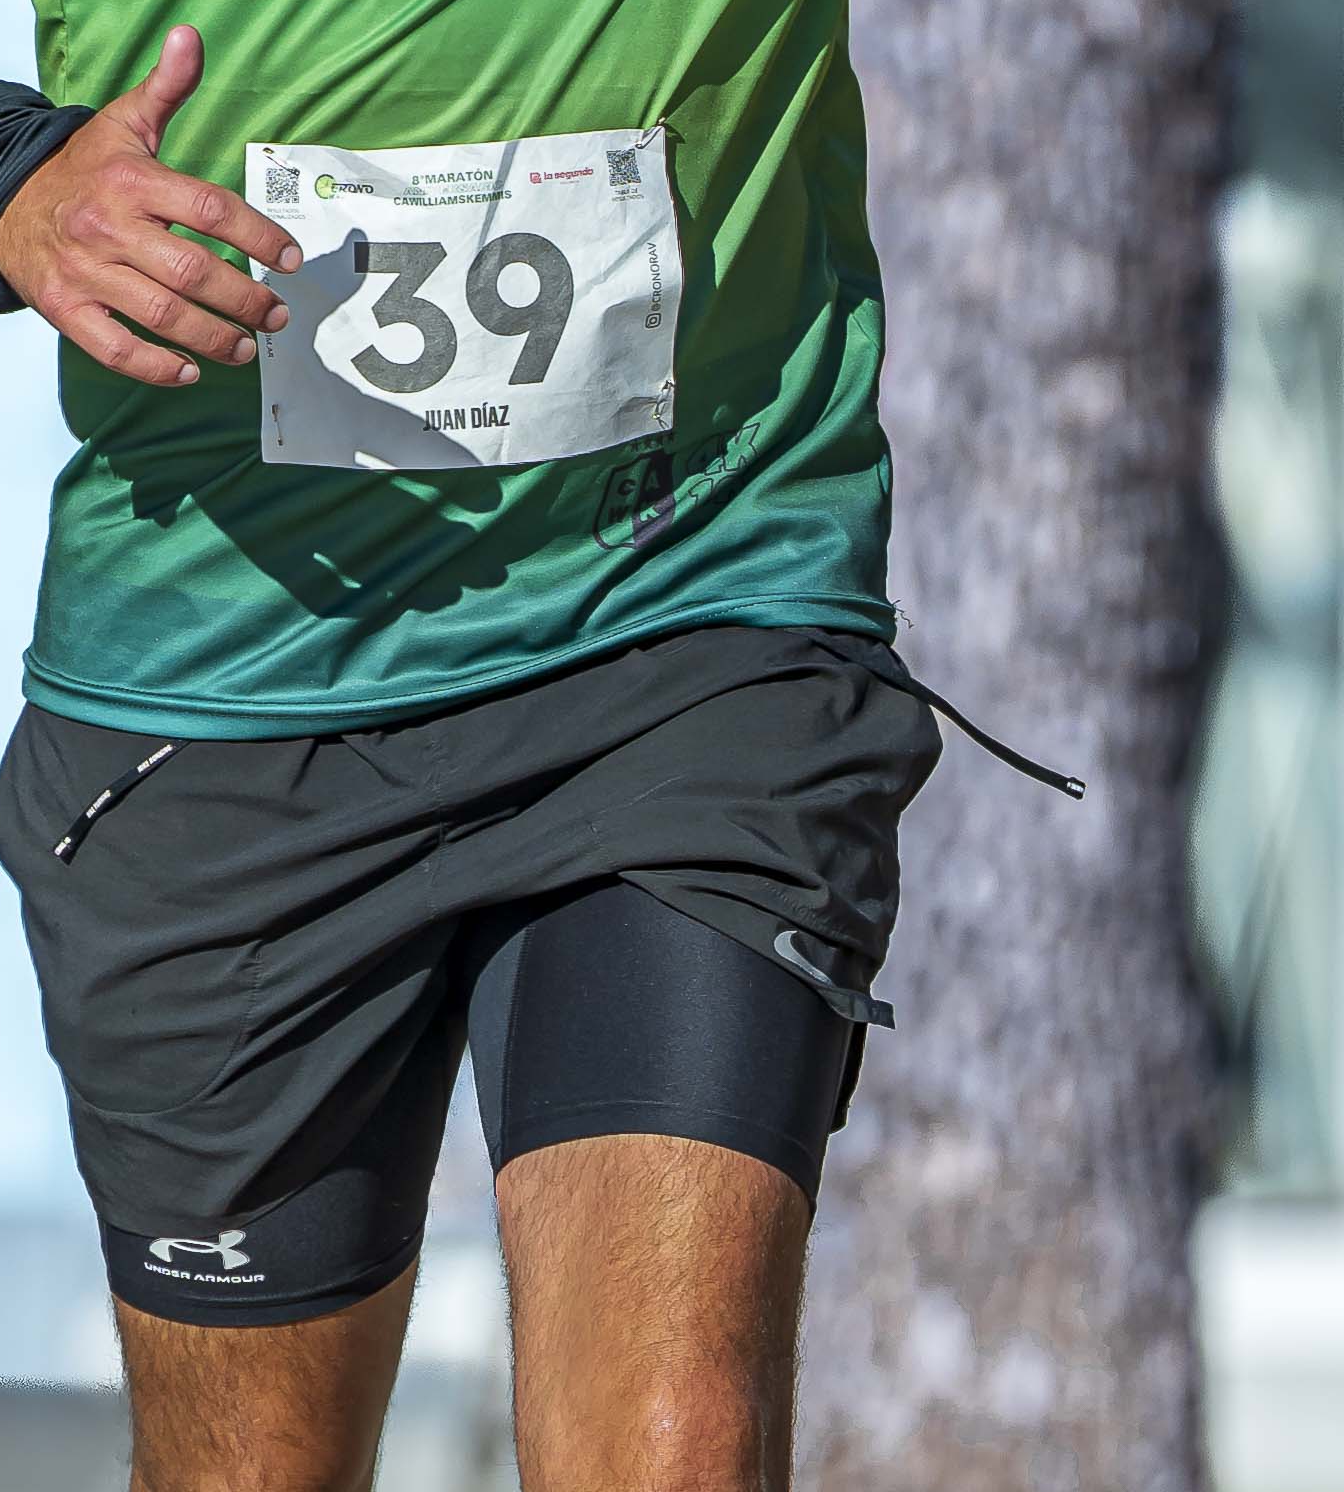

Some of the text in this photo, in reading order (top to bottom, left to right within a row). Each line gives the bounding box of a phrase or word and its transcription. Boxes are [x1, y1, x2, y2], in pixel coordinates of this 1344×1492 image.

[350, 232, 575, 394] 39
[423, 402, 511, 432] JUAN DÍAZ
[143, 1260, 266, 1284] UNDER ARMOUR
